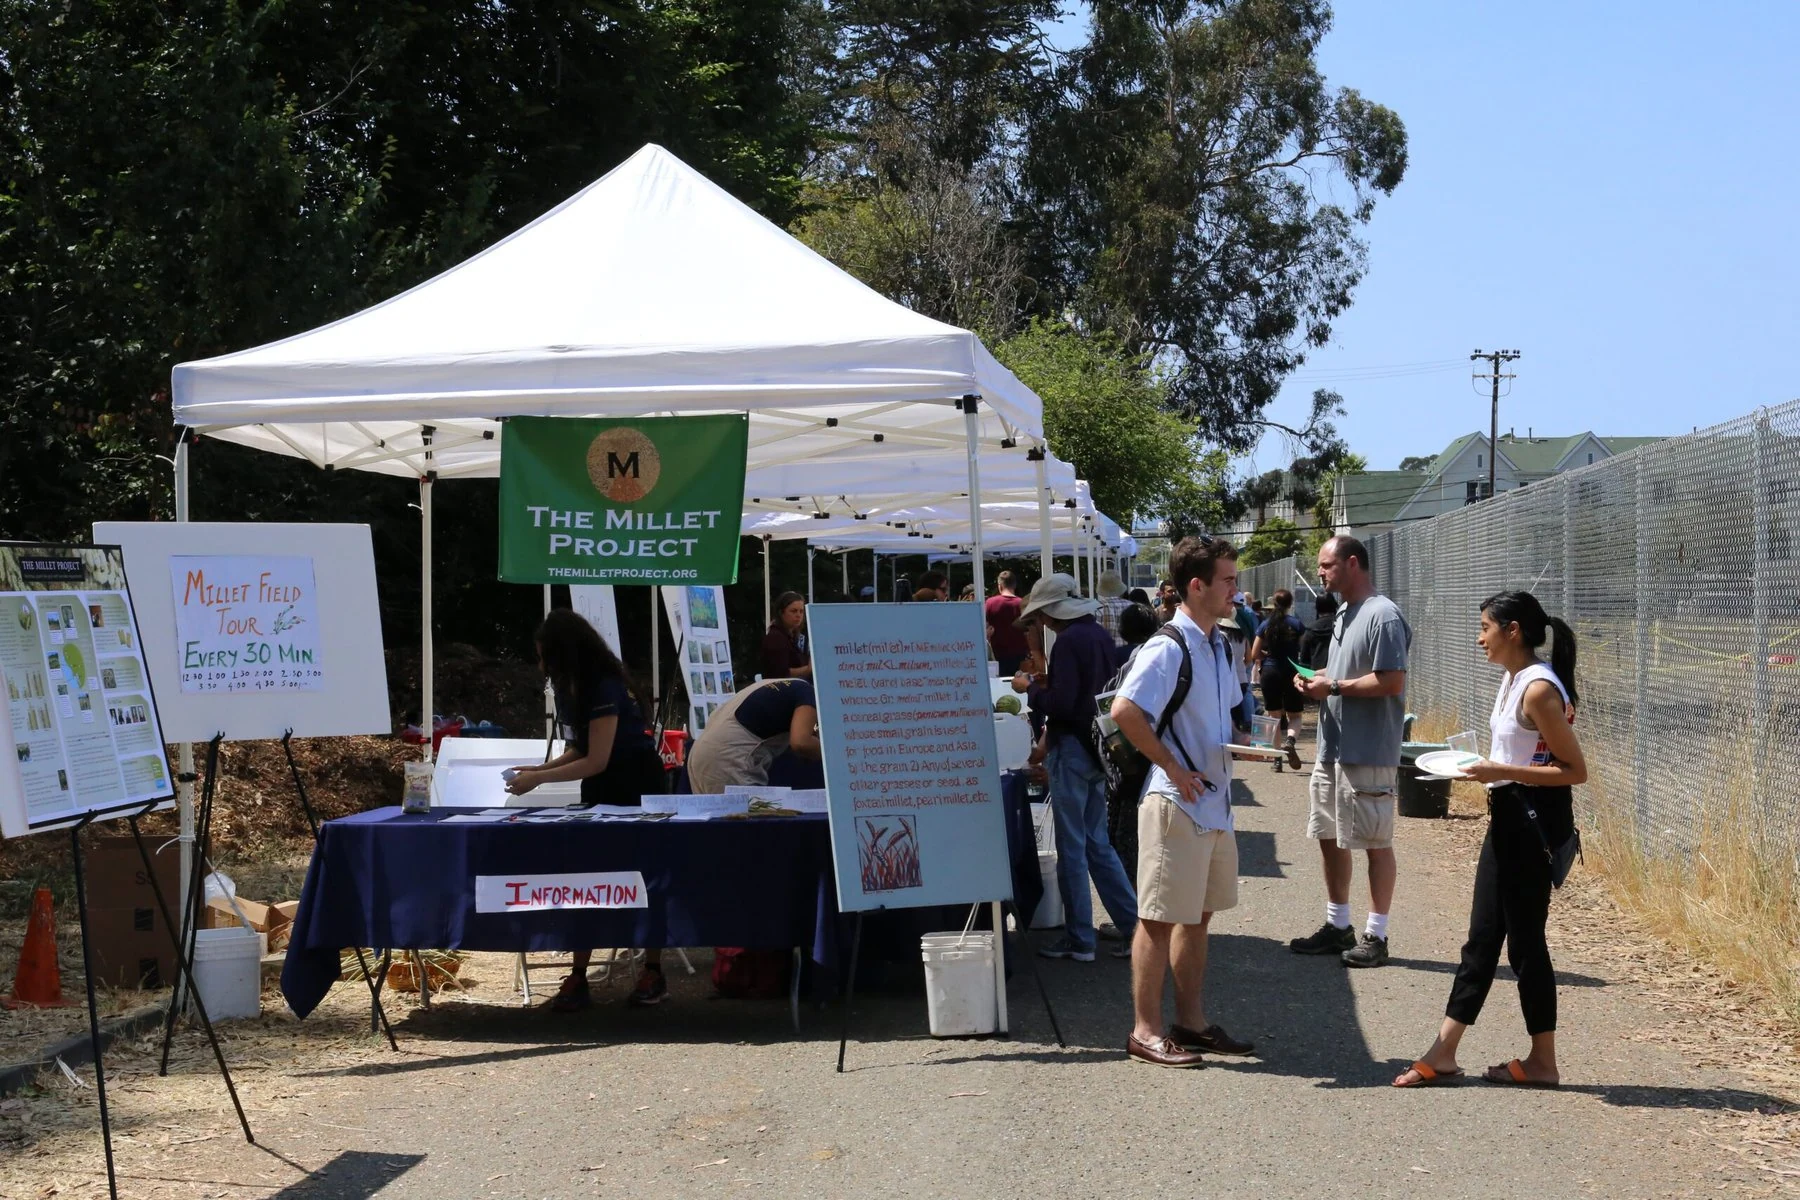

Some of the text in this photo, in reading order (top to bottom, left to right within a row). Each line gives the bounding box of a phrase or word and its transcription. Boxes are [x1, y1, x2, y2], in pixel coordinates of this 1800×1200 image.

[607, 452, 640, 478] M
[527, 505, 721, 530] THE MILLET
[548, 533, 699, 557] PROJECT
[21, 561, 80, 572] THE MILLET PROJECT
[547, 567, 698, 578] THEMILLETPROJECT.ORG
[184, 569, 301, 606] MILLET FIELD
[216, 607, 264, 636] TOUR
[184, 640, 238, 668] EVERY
[243, 642, 271, 664] 30
[843, 713, 849, 722] a
[882, 711, 913, 723] grass
[844, 729, 876, 740] whose
[904, 725, 934, 740] grain
[934, 724, 943, 736] is
[944, 723, 969, 735] used
[898, 742, 935, 755] Europe
[935, 741, 954, 753] and
[880, 762, 909, 774] grain
[922, 760, 940, 772] Any
[941, 756, 951, 772] of
[951, 756, 985, 769] several
[880, 779, 921, 793] grasses
[922, 780, 933, 789] or
[965, 776, 979, 786] as
[505, 882, 637, 906] INFORMATION
